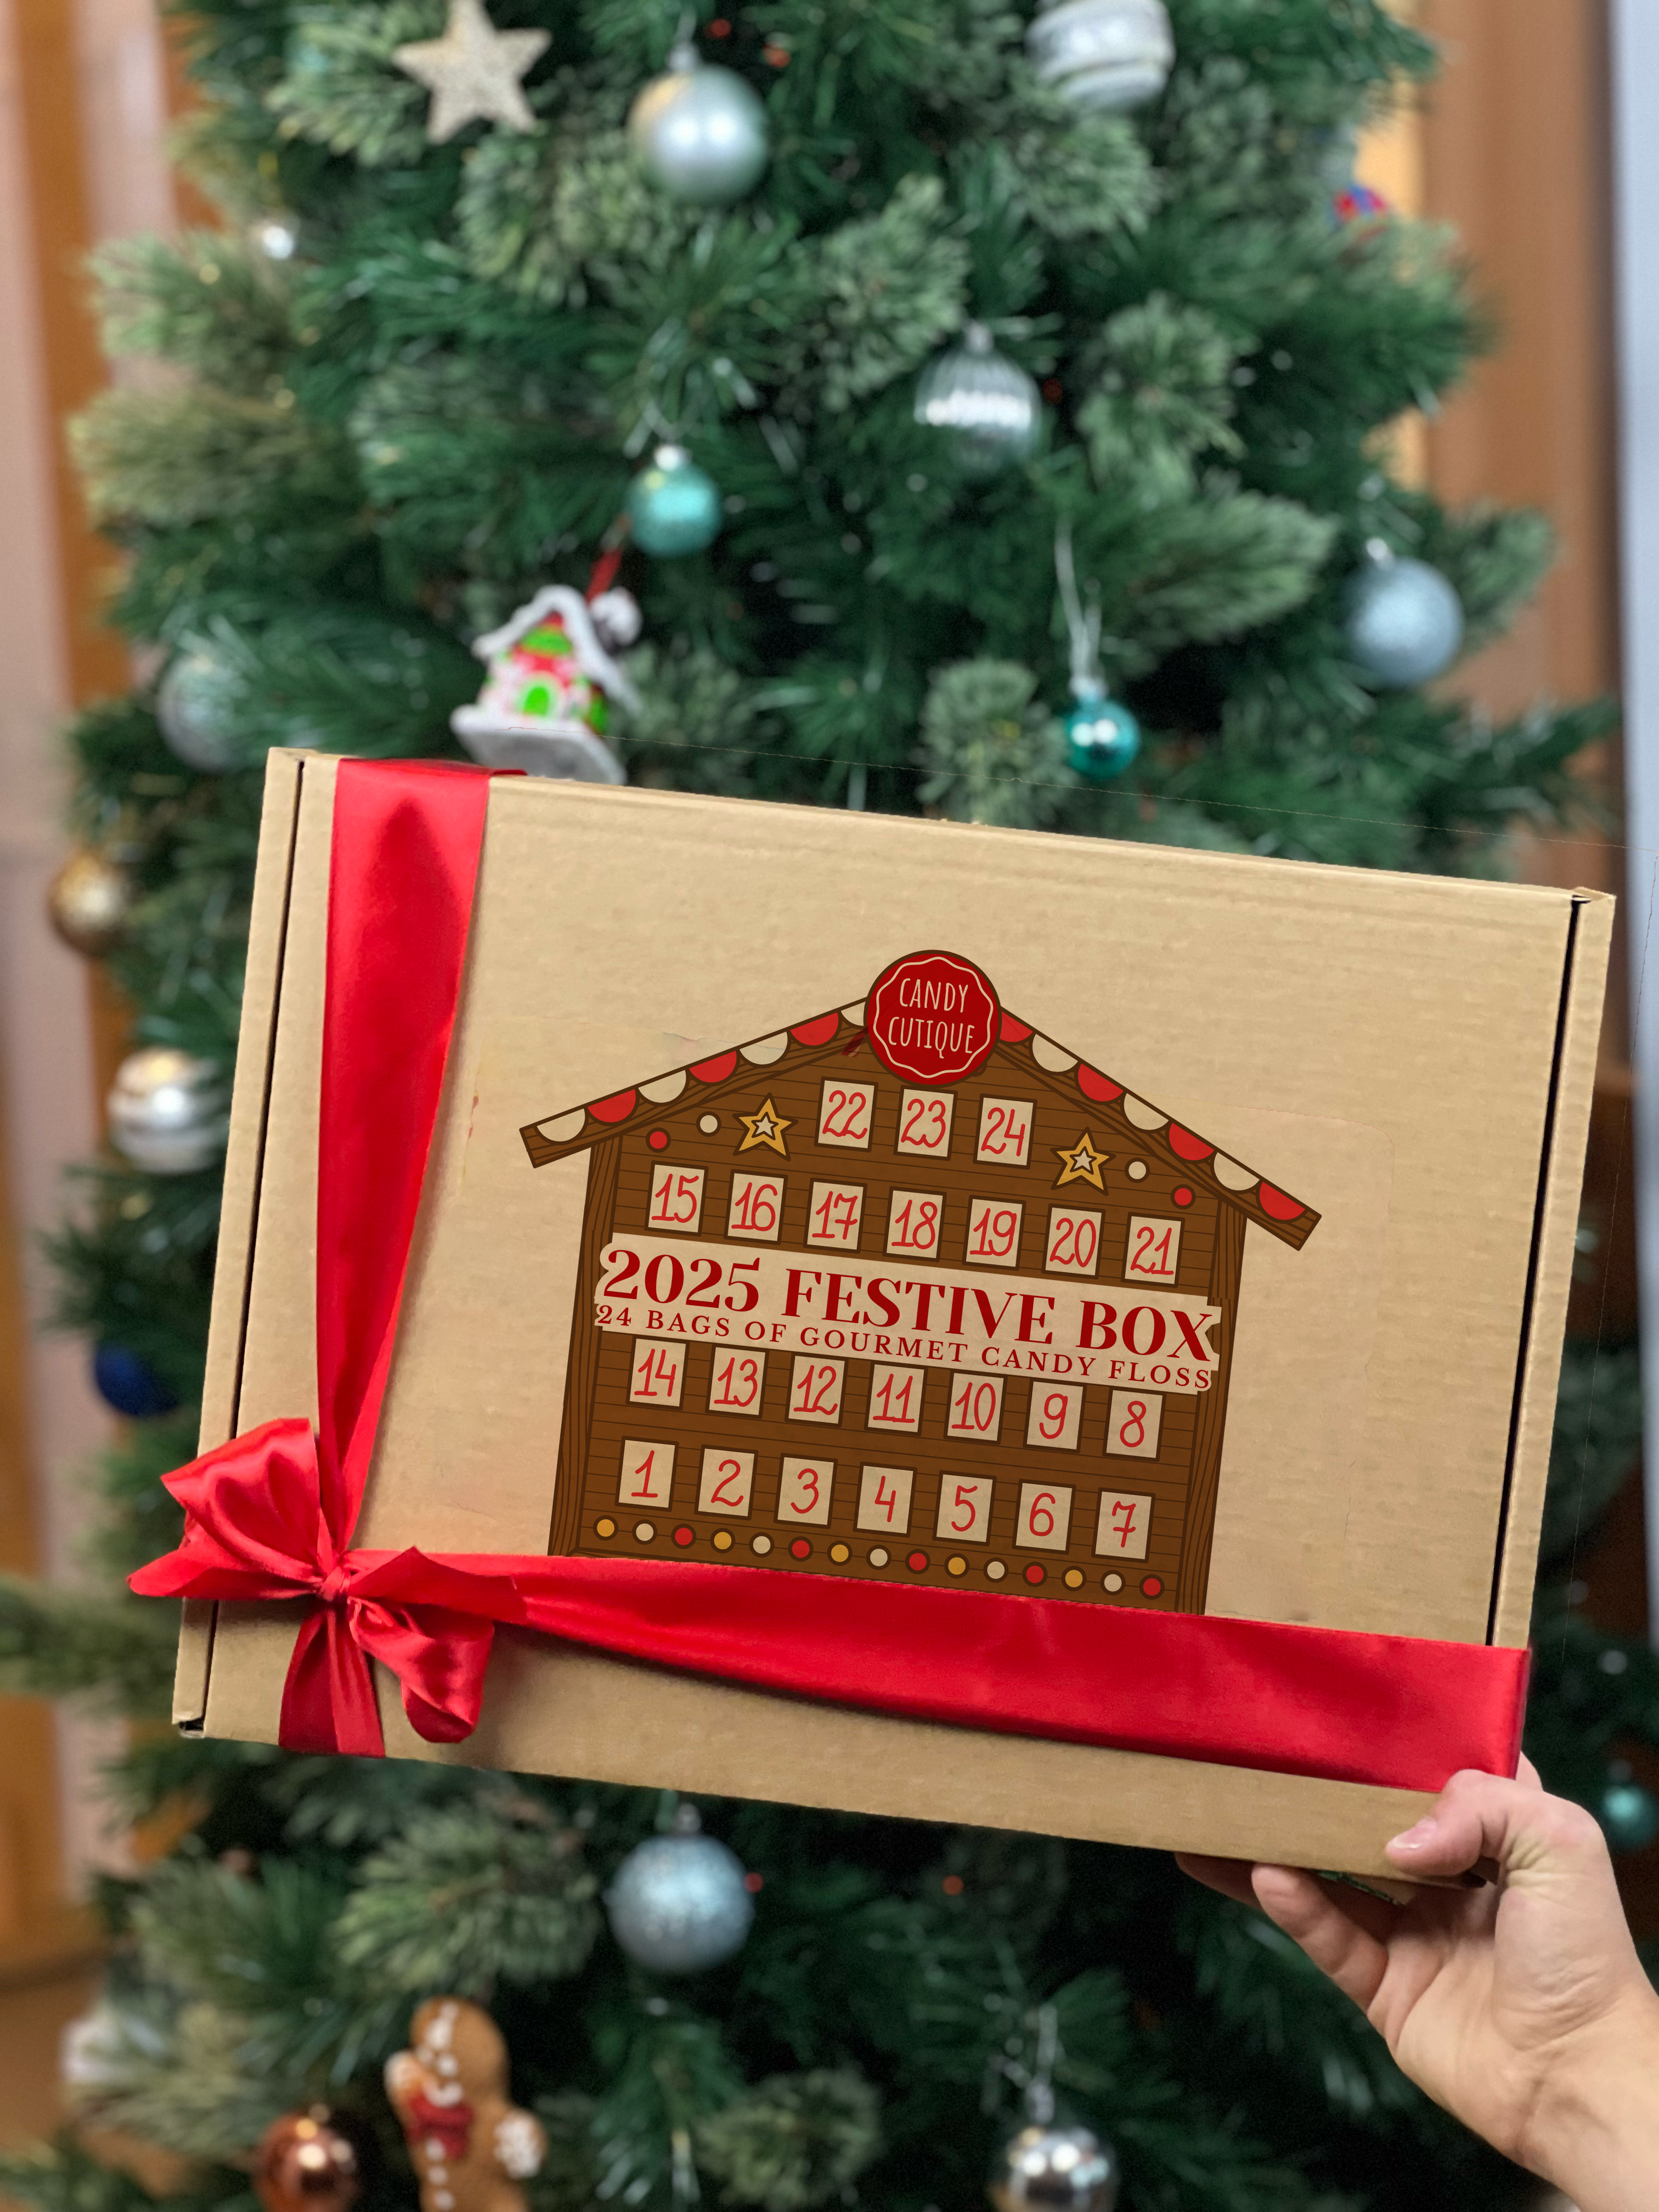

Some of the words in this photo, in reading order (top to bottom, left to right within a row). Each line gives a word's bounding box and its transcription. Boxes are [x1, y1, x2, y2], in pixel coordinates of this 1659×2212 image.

[889, 1017, 974, 1058] CUTIQUE
[900, 978, 968, 1012] CANDY
[822, 1090, 867, 1139] 22
[901, 1098, 946, 1148] 23
[981, 1107, 1025, 1156] 24
[652, 1173, 699, 1223] 15
[732, 1182, 777, 1231] 16
[812, 1190, 857, 1240] 17
[891, 1199, 938, 1250] 18
[970, 1208, 1017, 1256] 19
[1050, 1217, 1096, 1267] 20
[1131, 1227, 1174, 1275] 21
[597, 1305, 631, 1326] 24
[646, 1310, 729, 1336] BAGS
[744, 1321, 786, 1342] OF
[800, 1327, 968, 1362] GOURMET
[981, 1347, 1096, 1376] CANDY
[1108, 1359, 1210, 1389] FLOSS
[603, 1250, 760, 1312] 2025
[781, 1268, 1055, 1345] FESTIVE
[1075, 1300, 1212, 1362] BOX
[634, 1348, 676, 1397] 14
[714, 1357, 758, 1407] 13
[793, 1364, 838, 1415] 12
[872, 1373, 915, 1423] 11
[952, 1382, 996, 1431] 10
[1039, 1393, 1068, 1440] 9
[1120, 1401, 1147, 1448] 8
[631, 1450, 658, 1498] 1
[710, 1459, 744, 1507] 2
[791, 1468, 819, 1514] 3
[874, 1475, 896, 1522] 4
[951, 1485, 978, 1532] 5
[1029, 1492, 1056, 1537] 6
[1111, 1500, 1136, 1548] 7
